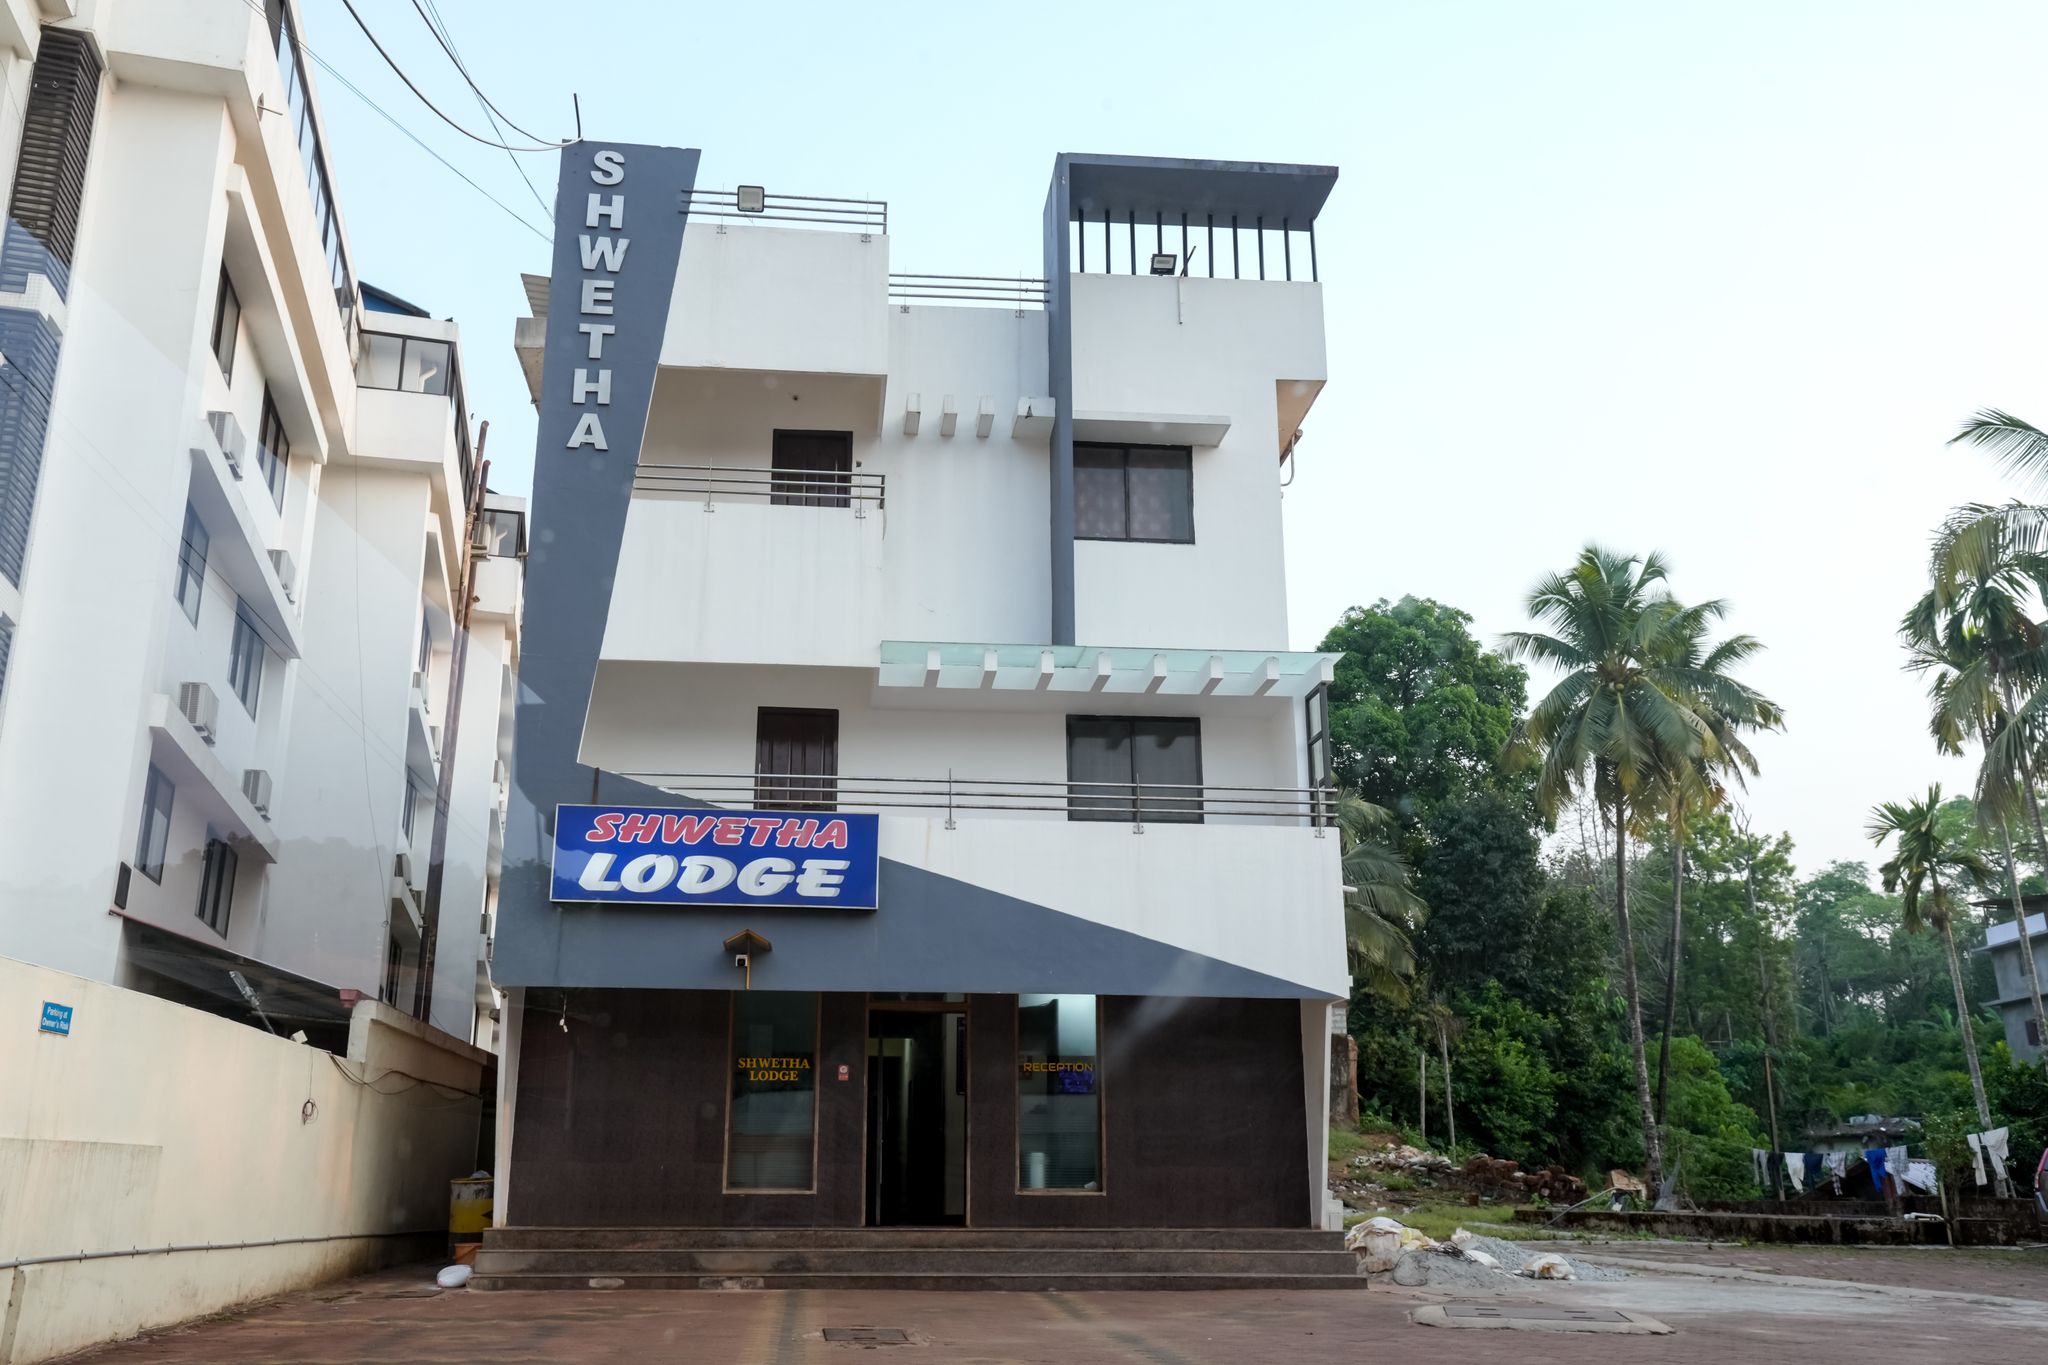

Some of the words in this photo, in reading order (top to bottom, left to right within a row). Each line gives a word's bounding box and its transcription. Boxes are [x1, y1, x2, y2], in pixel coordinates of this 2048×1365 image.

[566, 150, 630, 451] SHWETHA
[585, 813, 848, 849] SHWETHA
[578, 852, 850, 897] LODGE
[738, 1057, 810, 1069] SHWETHA
[1023, 1062, 1093, 1072] RECEPTION
[749, 1070, 799, 1081] LODGE
